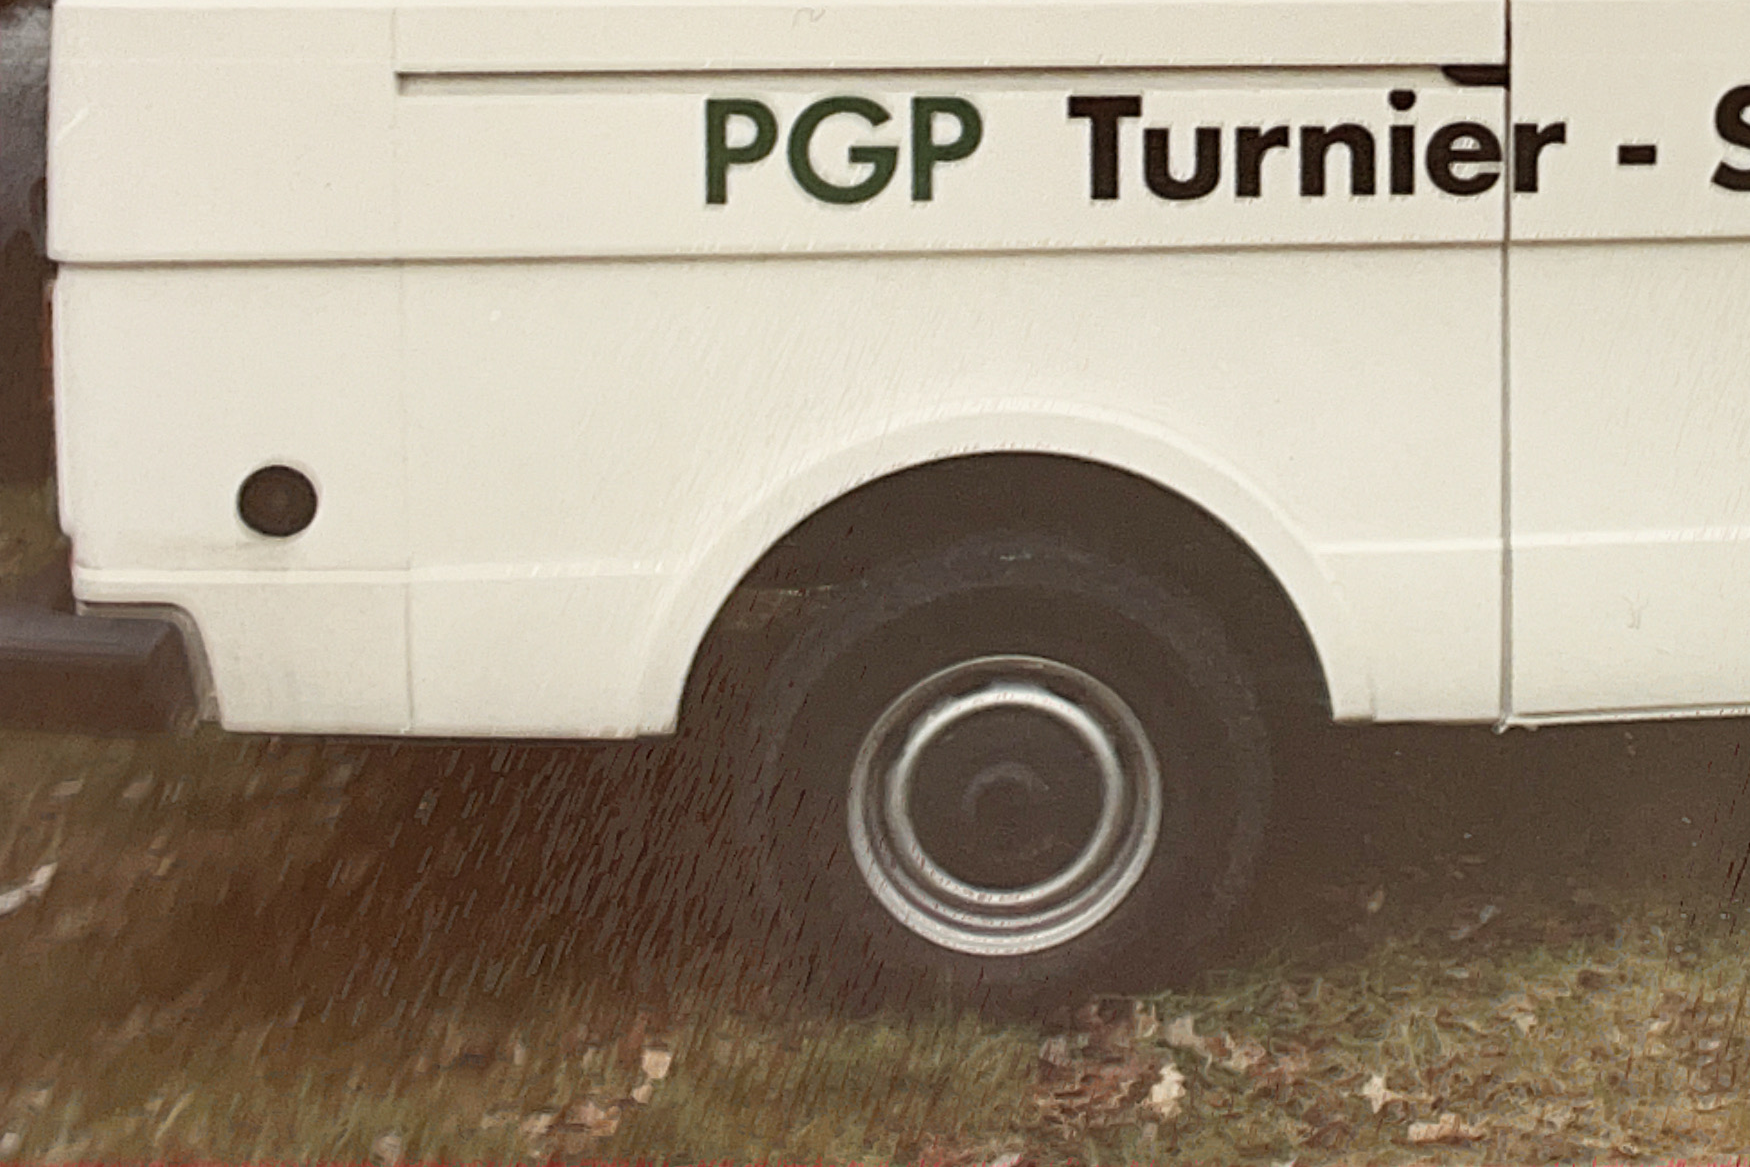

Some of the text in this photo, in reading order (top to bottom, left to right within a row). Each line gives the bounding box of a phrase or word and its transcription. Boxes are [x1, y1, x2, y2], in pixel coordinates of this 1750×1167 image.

[704, 96, 983, 205] PGP
[1066, 89, 1567, 201] Turnier
[1618, 142, 1657, 165] -
